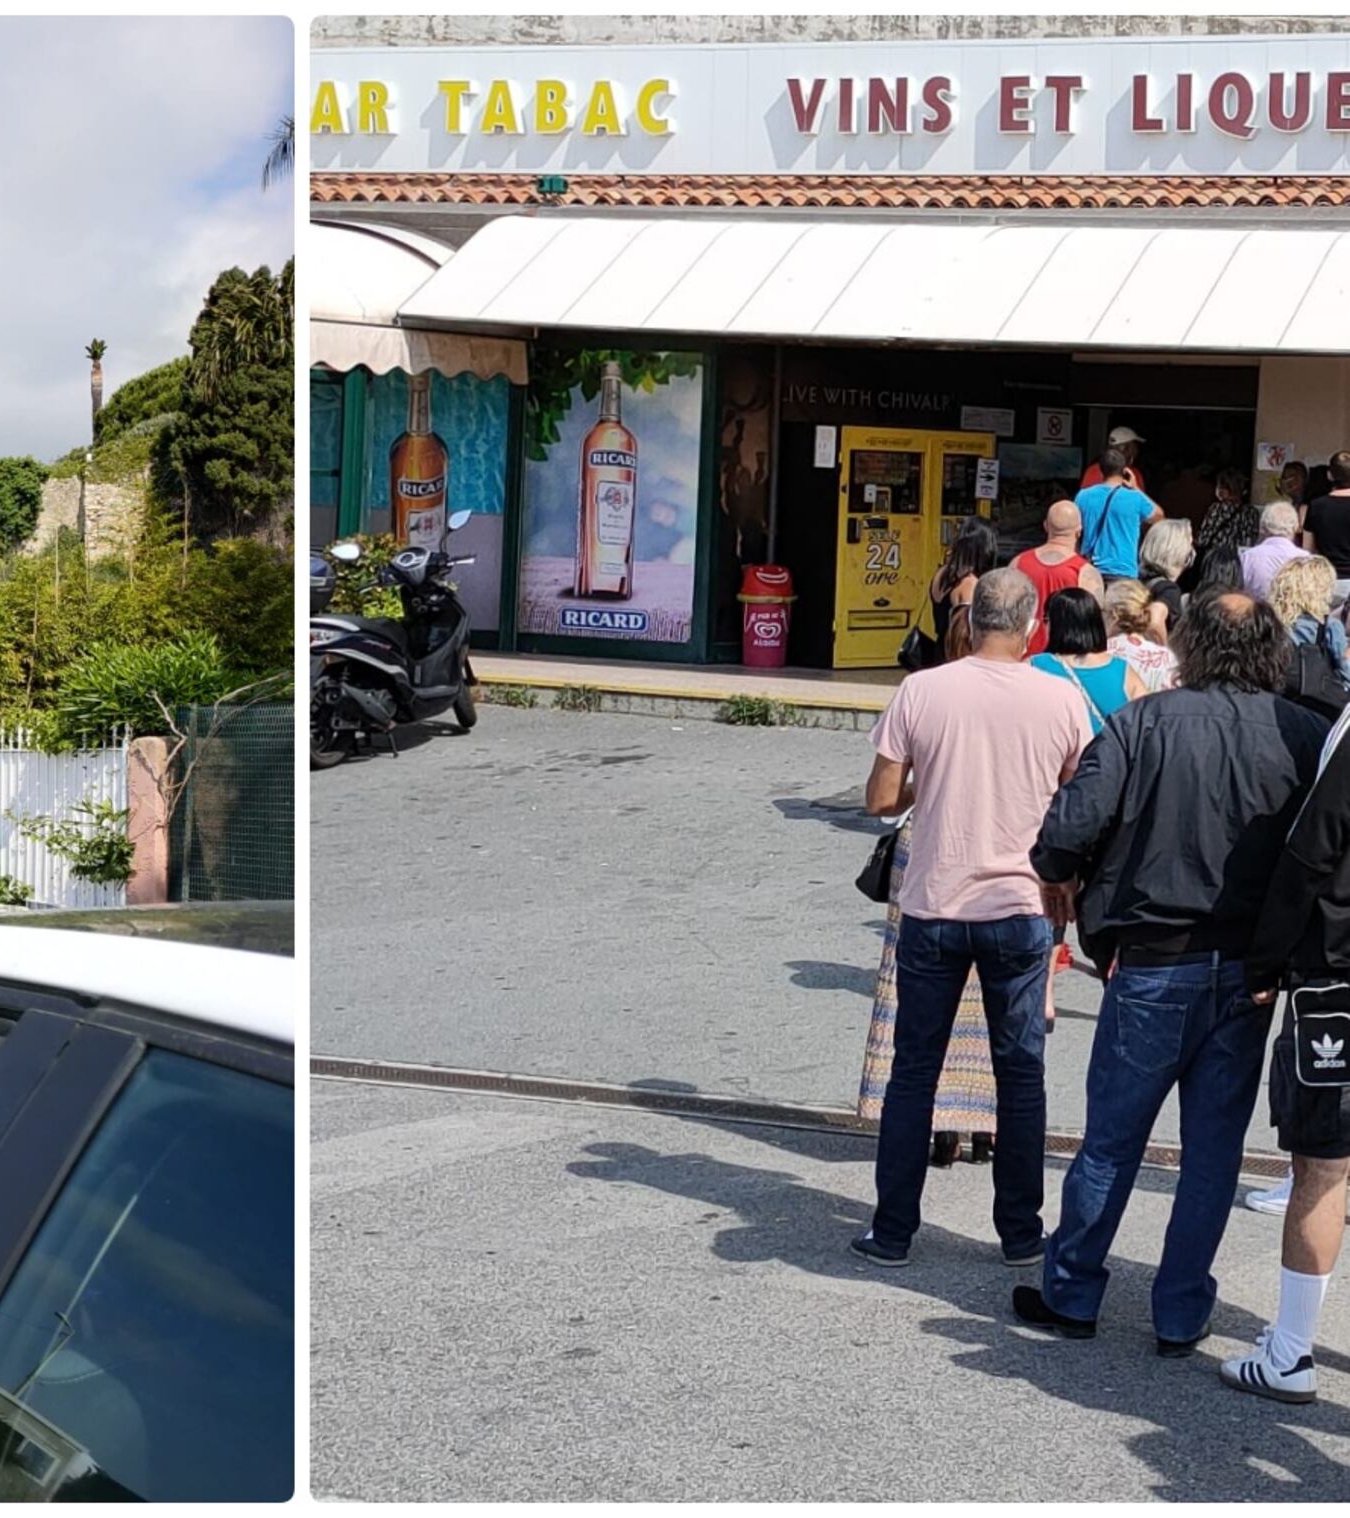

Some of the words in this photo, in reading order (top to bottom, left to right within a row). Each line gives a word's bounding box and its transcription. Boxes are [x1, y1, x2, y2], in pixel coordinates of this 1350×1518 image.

[310, 80, 392, 134] AR
[438, 79, 673, 135] TABAC
[786, 76, 953, 134] VINS
[998, 75, 1083, 134] ET
[1131, 71, 1350, 139] LIQUE
[783, 384, 817, 403] IVE
[824, 387, 873, 407] WITH
[877, 391, 955, 412] CHIVALR
[865, 543, 902, 571] 24
[564, 610, 645, 630] RICARD
